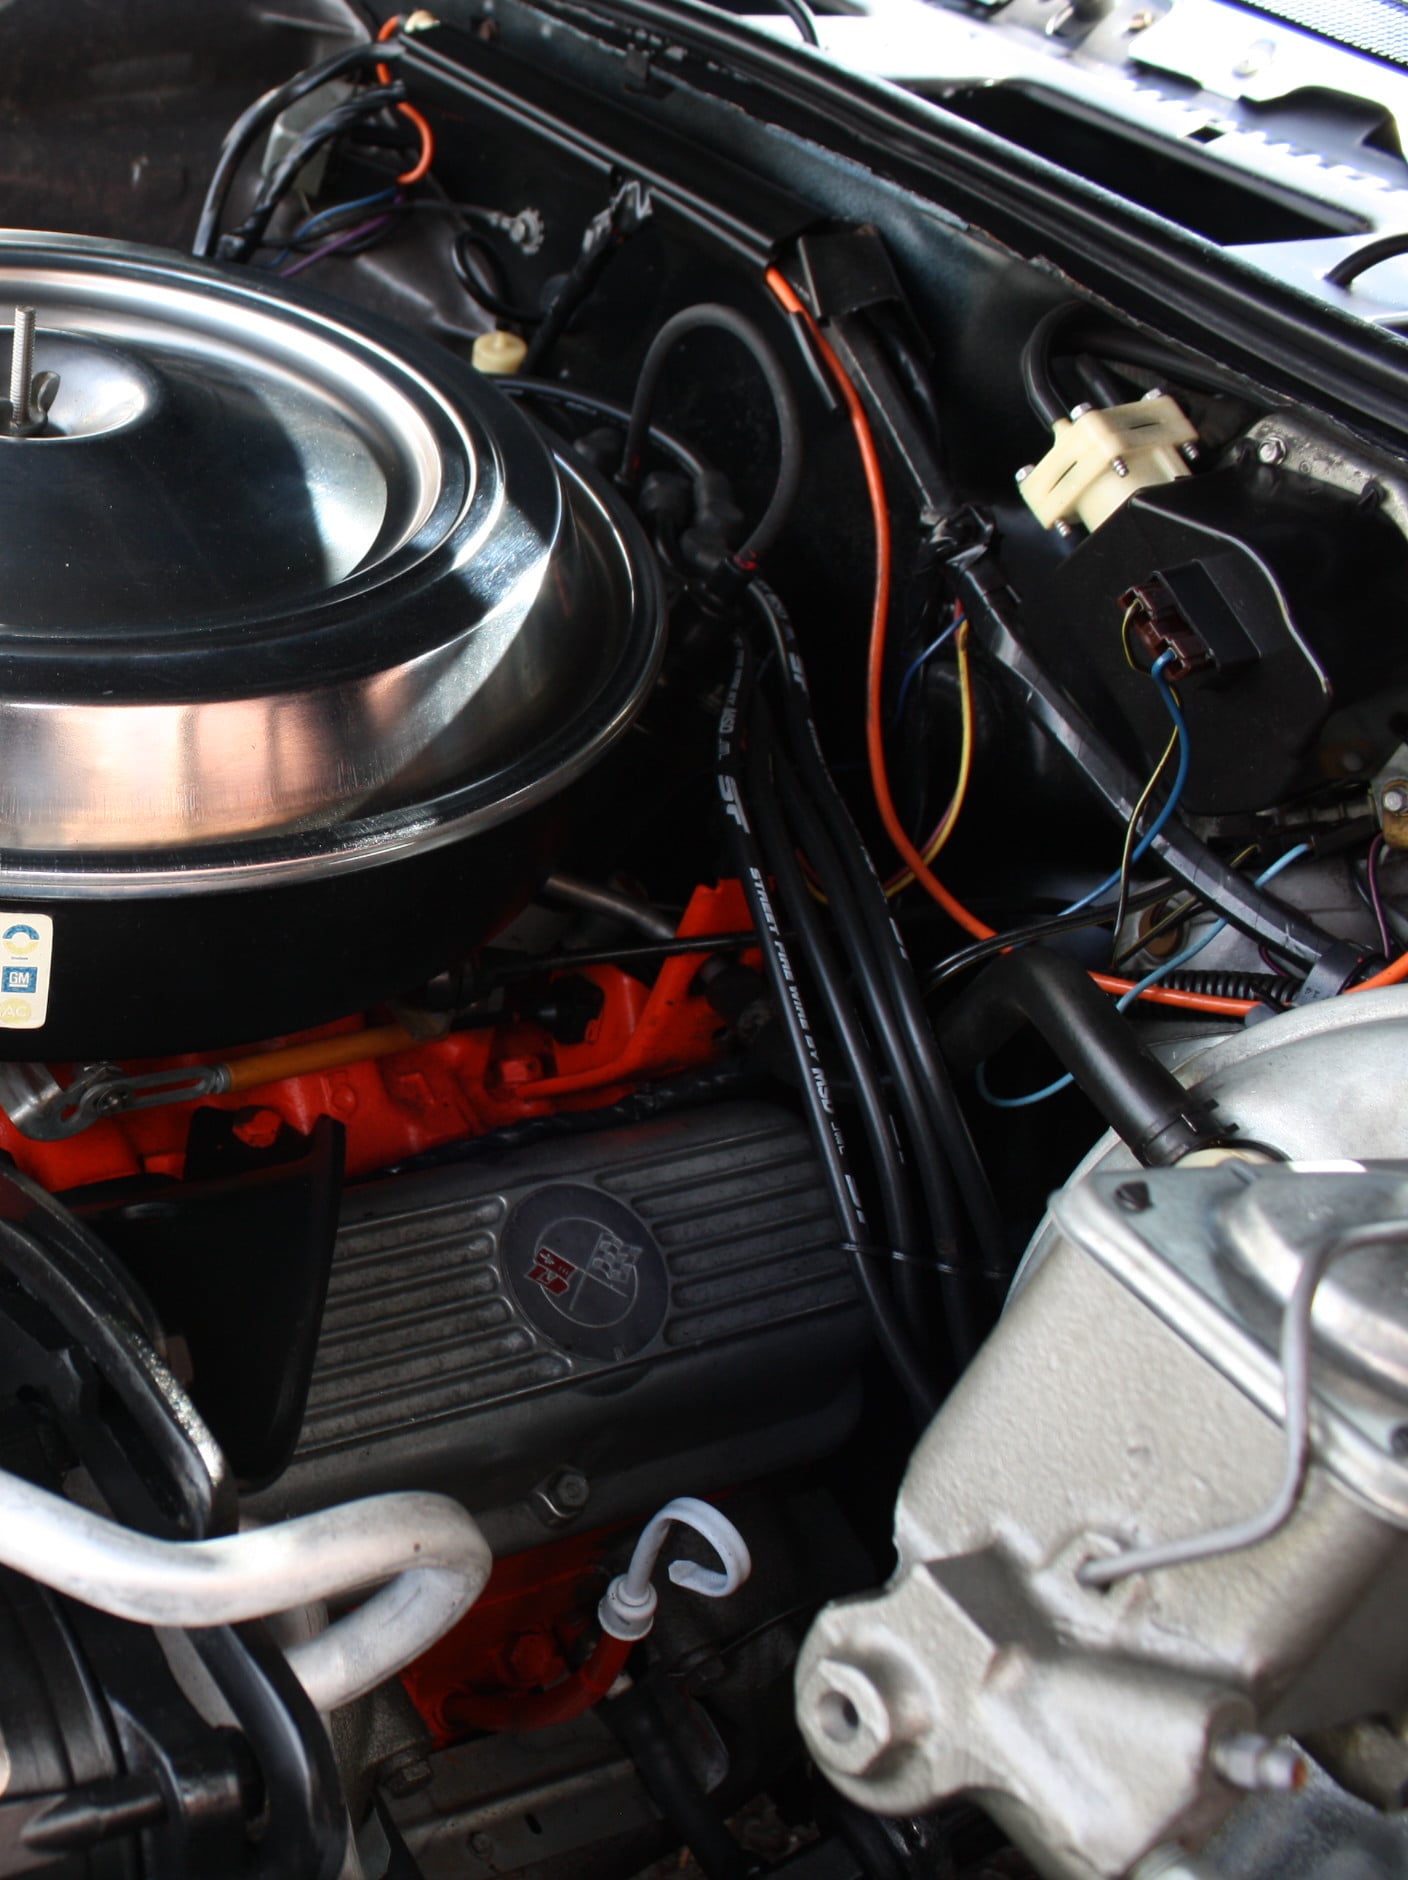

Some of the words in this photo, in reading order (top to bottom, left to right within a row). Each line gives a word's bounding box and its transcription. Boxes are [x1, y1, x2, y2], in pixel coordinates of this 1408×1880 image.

[749, 866, 780, 936] STREET
[774, 940, 794, 979] FIRE
[9, 971, 30, 988] GM
[2, 1005, 28, 1018] AC
[788, 985, 810, 1029] WIRE
[804, 1034, 821, 1062] BY
[810, 1066, 834, 1115] MSD
